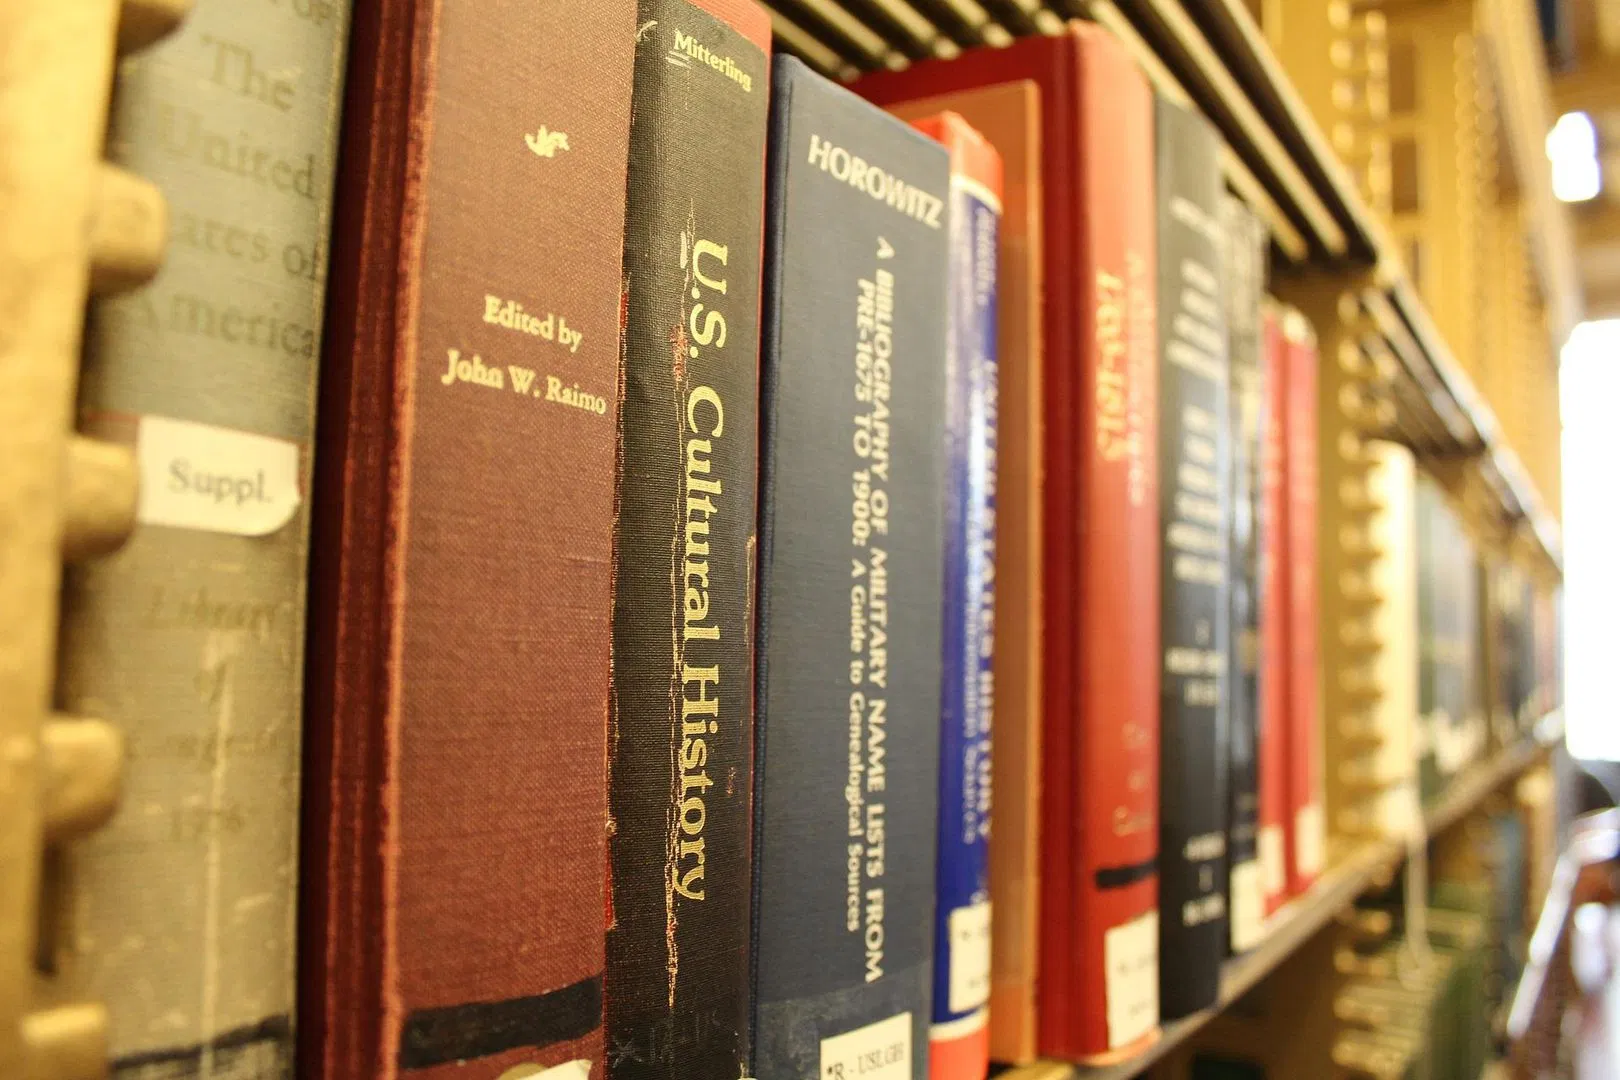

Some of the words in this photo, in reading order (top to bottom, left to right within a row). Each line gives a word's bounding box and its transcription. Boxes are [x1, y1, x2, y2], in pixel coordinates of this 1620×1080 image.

[200, 35, 296, 113] The
[672, 29, 752, 93] Mitterling
[157, 102, 317, 200] United
[808, 134, 944, 229] HOROWITZ
[170, 211, 270, 263] ates
[876, 235, 895, 259] A
[484, 294, 554, 339] Edited
[558, 317, 582, 353] by
[689, 239, 728, 359] U.S.
[854, 278, 876, 401] PRE-1675
[870, 269, 894, 482] BIBLIOGRAPHY
[441, 349, 504, 389] John
[508, 366, 541, 399] W.
[546, 375, 607, 415] Raimo
[853, 413, 872, 458] TO
[168, 457, 273, 506] Suppl.
[684, 385, 724, 641] Cultural
[852, 469, 871, 546] 1900:
[870, 489, 889, 535] OF
[851, 559, 867, 578] A
[851, 585, 867, 652] Guide
[869, 548, 888, 688] MILITARY
[850, 660, 865, 685] to
[673, 663, 719, 900] History
[845, 691, 866, 836] Genealogical
[867, 699, 887, 792] NAME
[866, 804, 885, 878] LISTS
[847, 844, 864, 931] Sources
[865, 888, 884, 983] FROM
